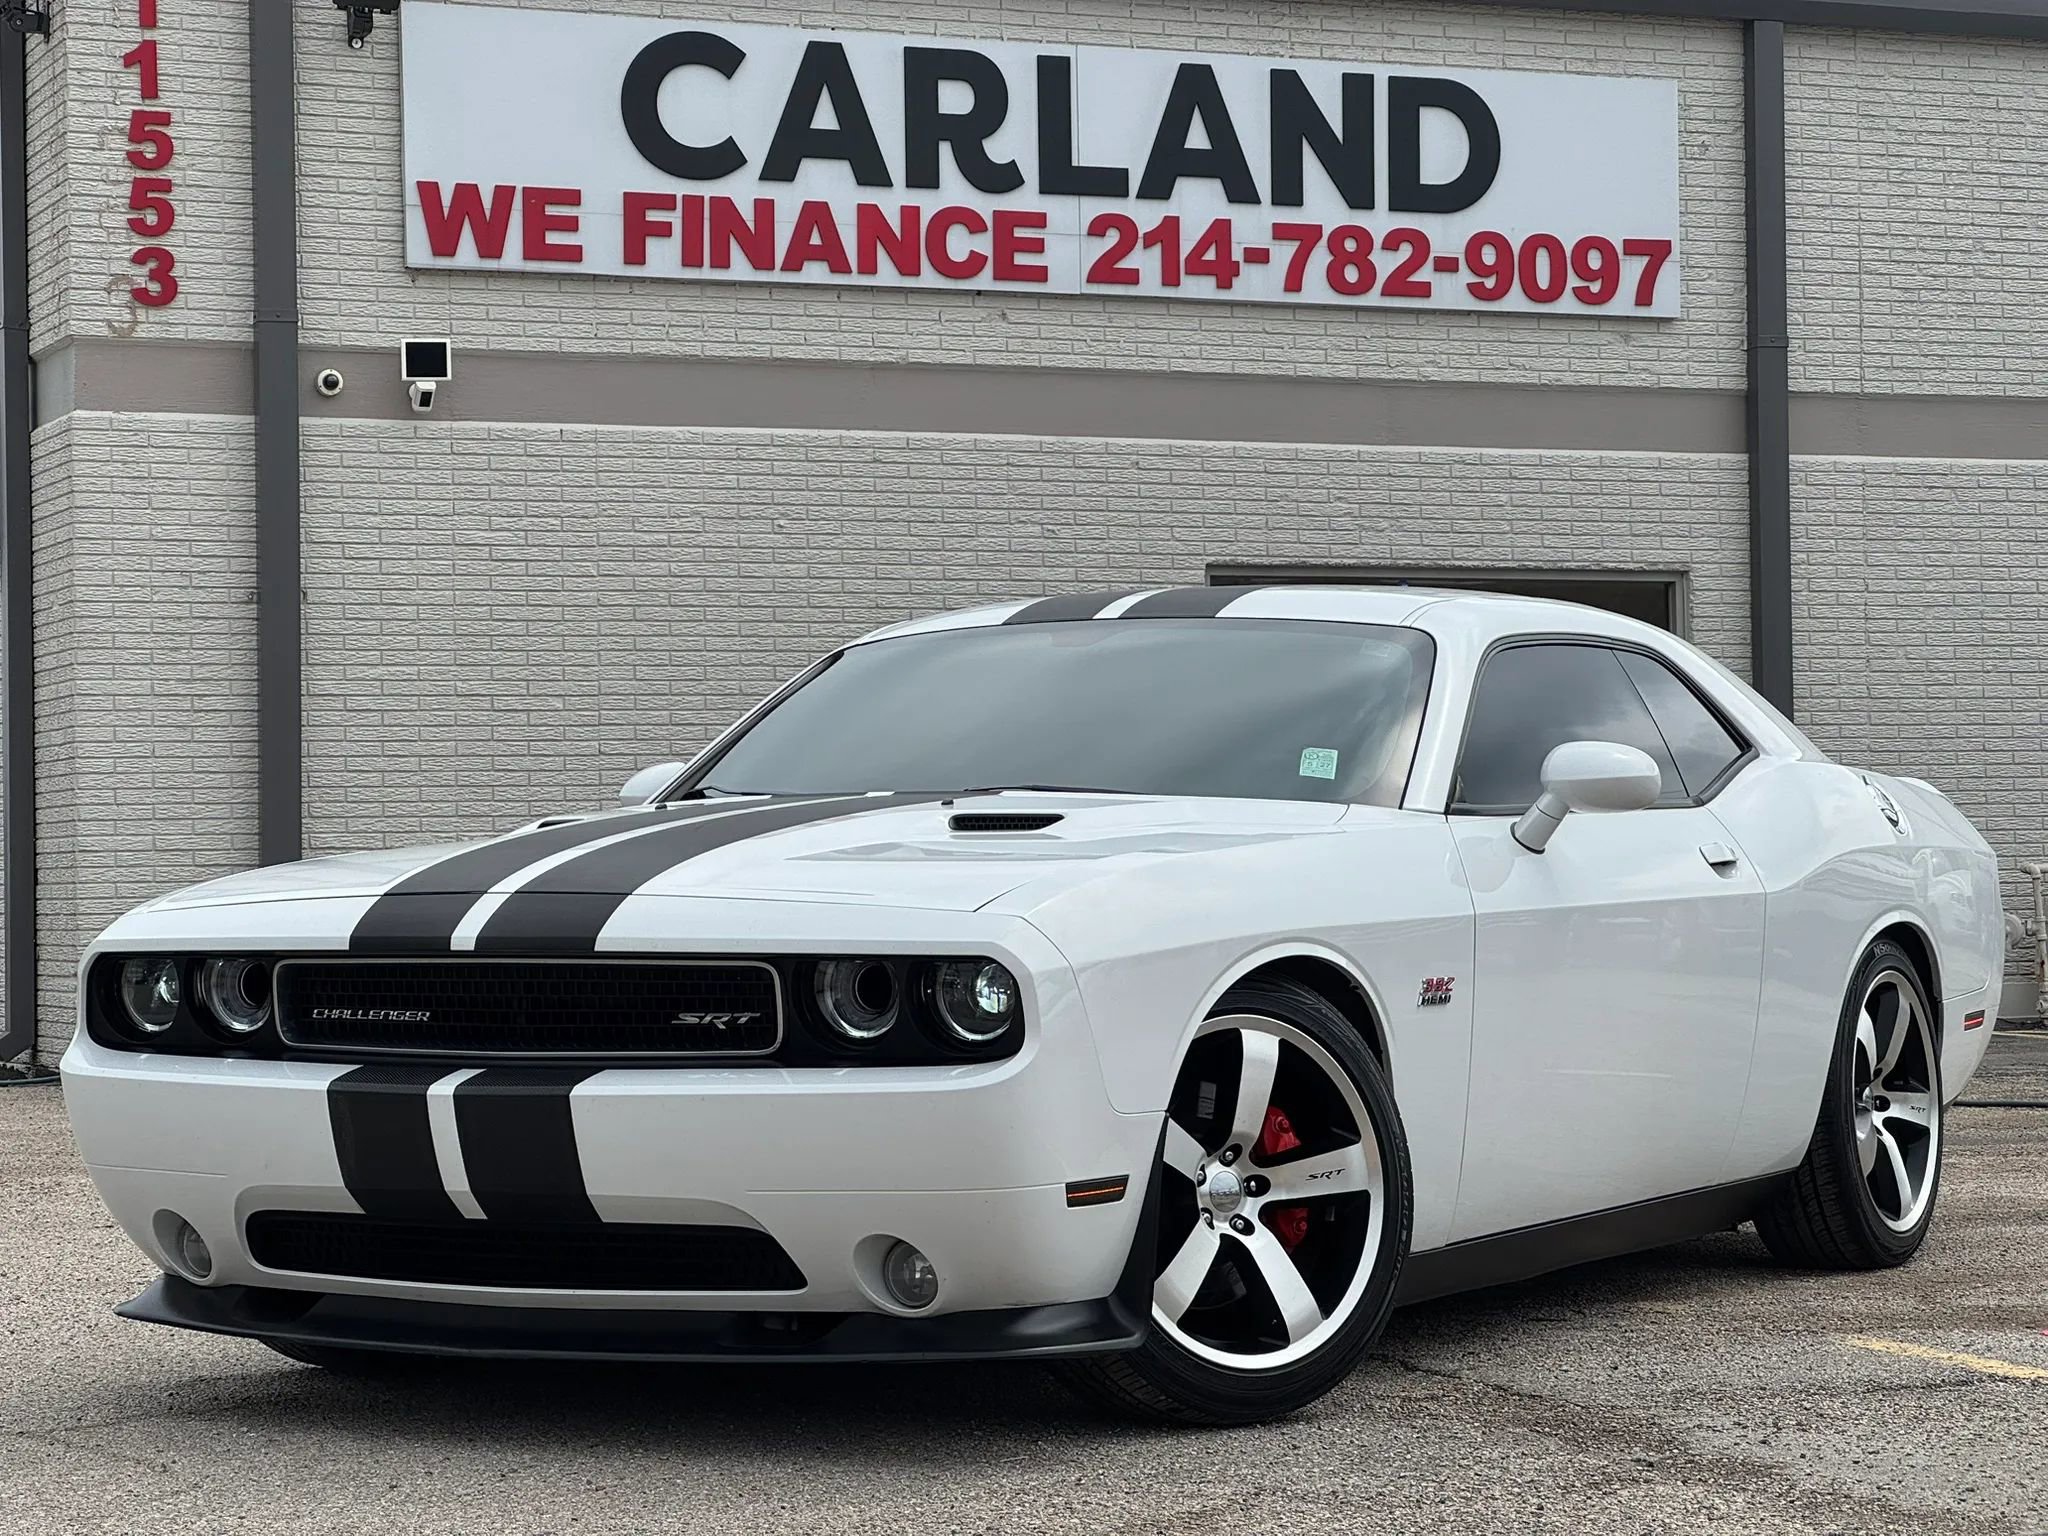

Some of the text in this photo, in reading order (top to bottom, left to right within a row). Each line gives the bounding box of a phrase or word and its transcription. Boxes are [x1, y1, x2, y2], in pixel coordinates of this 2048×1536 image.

[621, 30, 1501, 214] CARLAND
[416, 180, 1672, 307] WE FINANCE 214-782-9097
[1417, 991, 1452, 1007] HEMI
[312, 1008, 430, 1021] CHALLENGER
[671, 1012, 761, 1030] SRT
[1304, 1168, 1347, 1181] SRT
